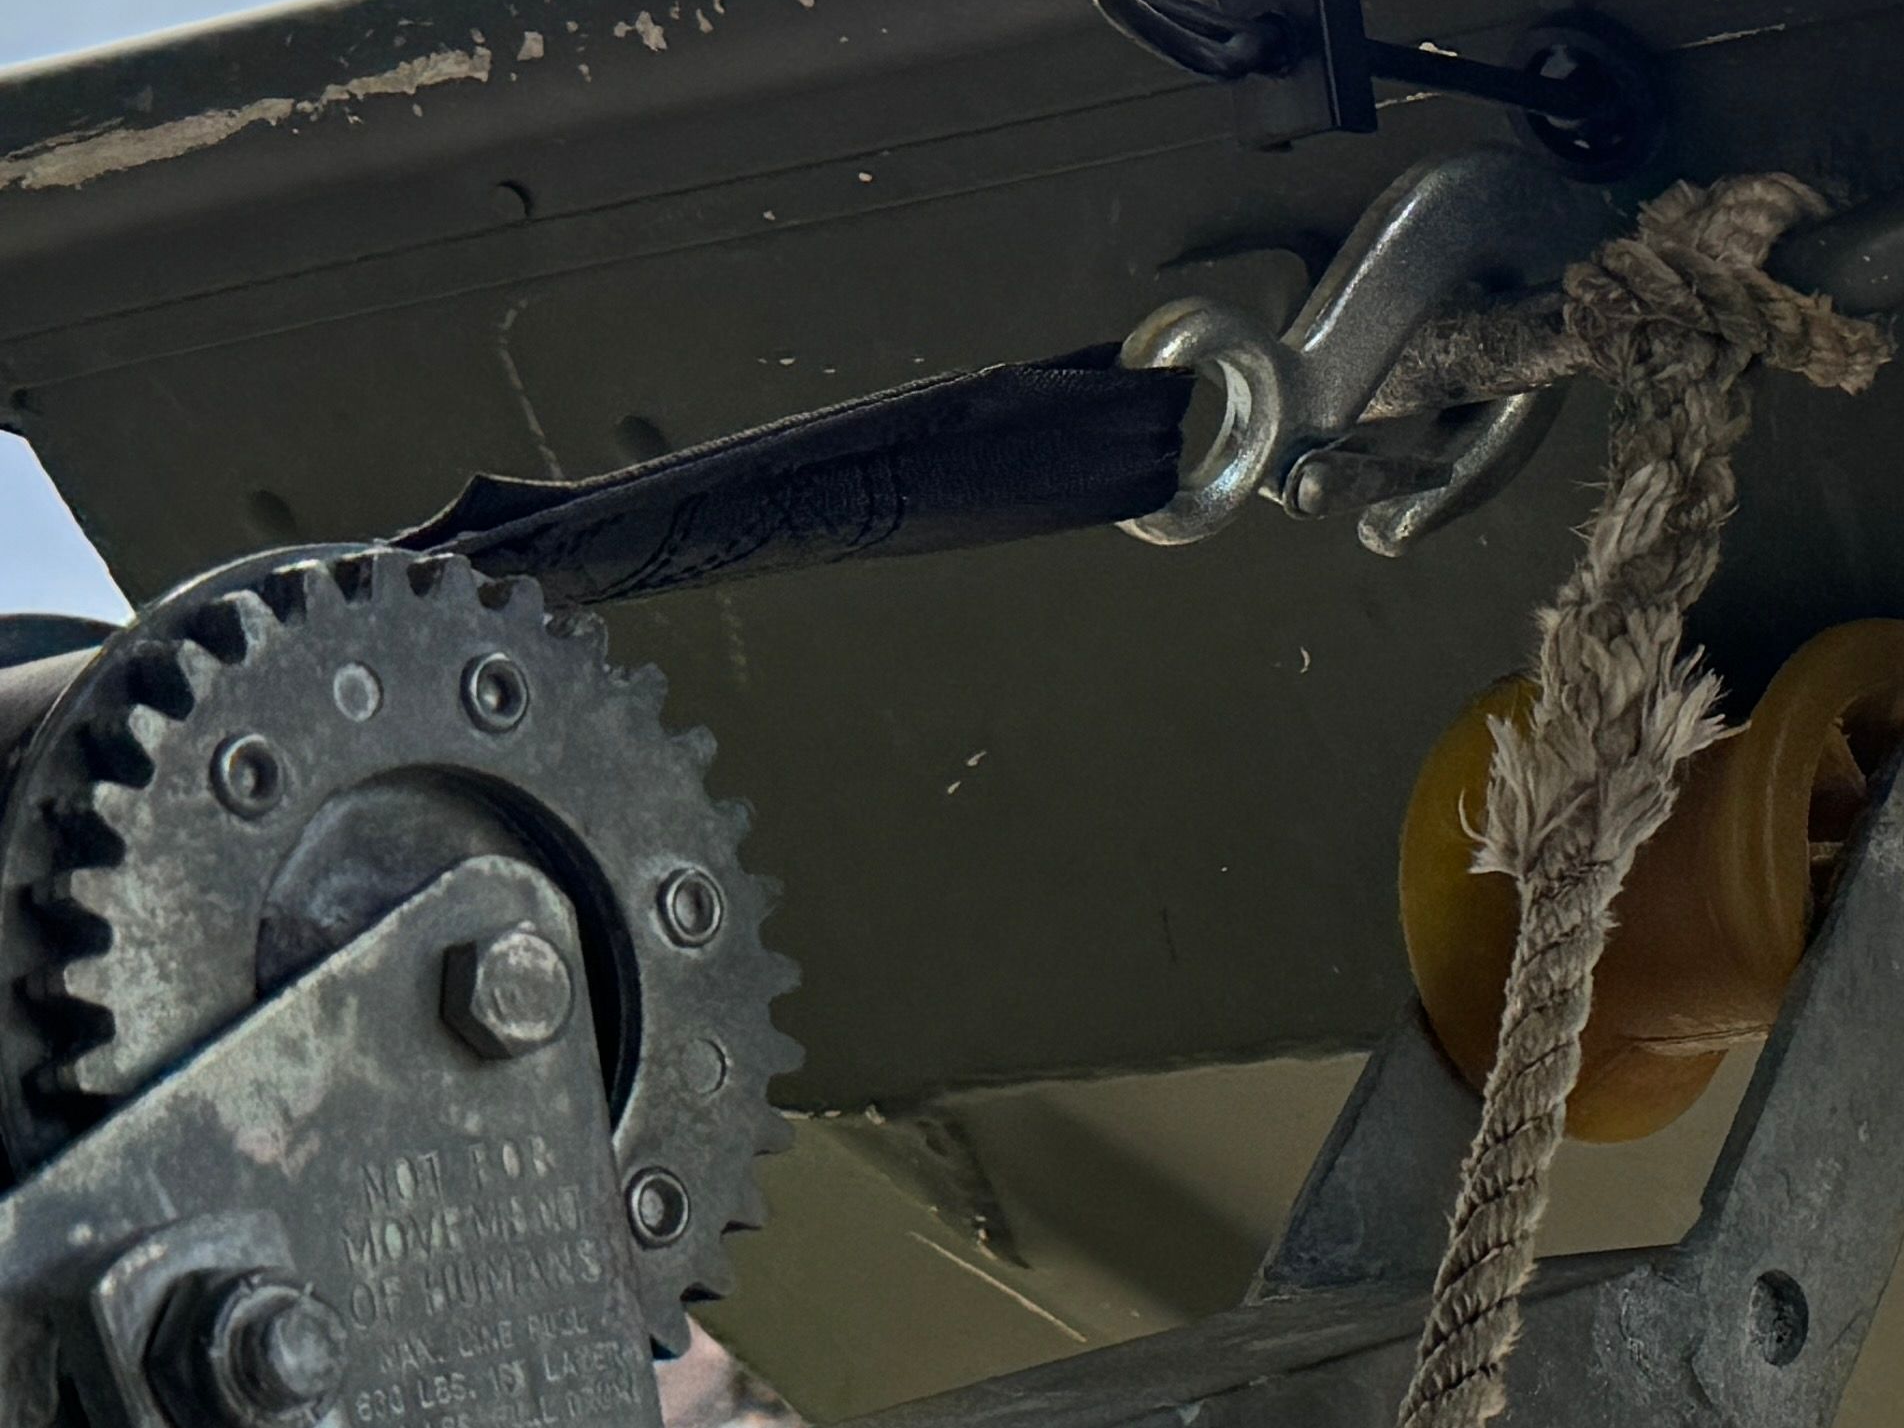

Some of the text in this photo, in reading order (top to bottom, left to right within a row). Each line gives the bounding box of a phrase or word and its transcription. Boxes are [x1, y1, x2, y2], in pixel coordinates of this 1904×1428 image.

[360, 1135, 557, 1210] NOT FOR
[351, 1238, 602, 1331] OF HUMANS
